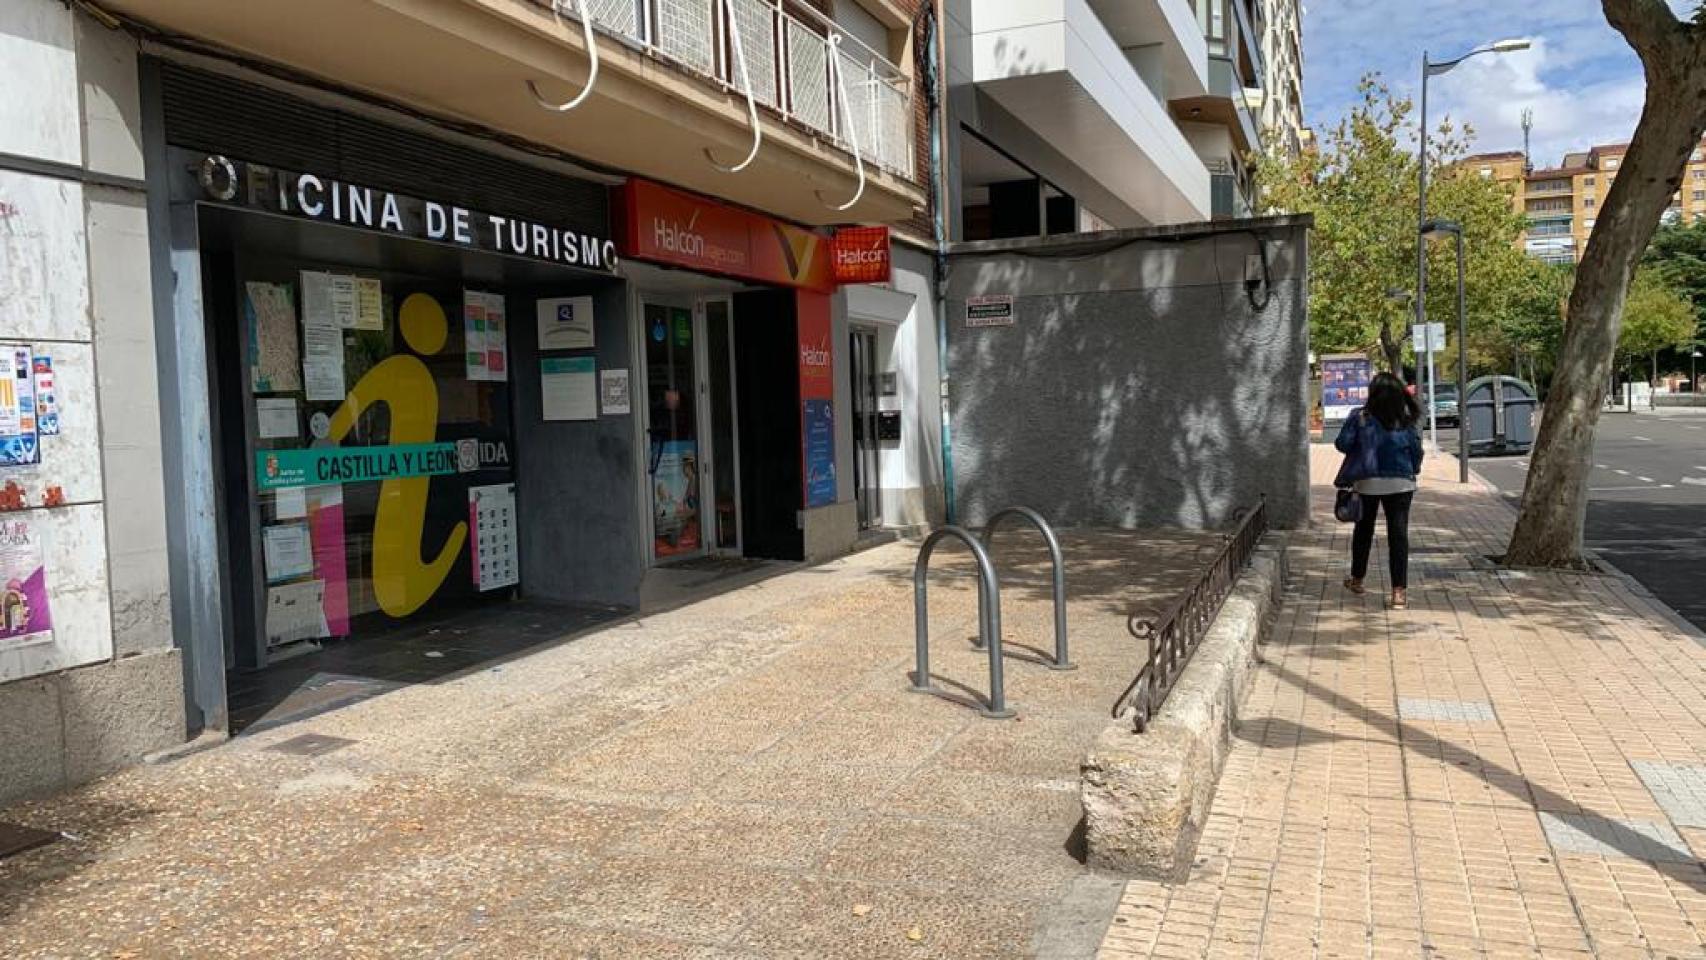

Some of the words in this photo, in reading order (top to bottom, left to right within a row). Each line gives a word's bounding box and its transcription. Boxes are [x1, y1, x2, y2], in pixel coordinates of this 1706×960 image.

[199, 155, 404, 232] OFICINA
[425, 201, 471, 244] DE
[489, 215, 619, 271] TURISMO
[654, 208, 704, 258] Halcón
[837, 235, 887, 265] Halcón
[801, 337, 829, 366] Halcón
[317, 452, 397, 481] CASTILLA
[402, 451, 415, 473] Y
[418, 446, 454, 473] LEÓN
[479, 441, 509, 464] IDA
